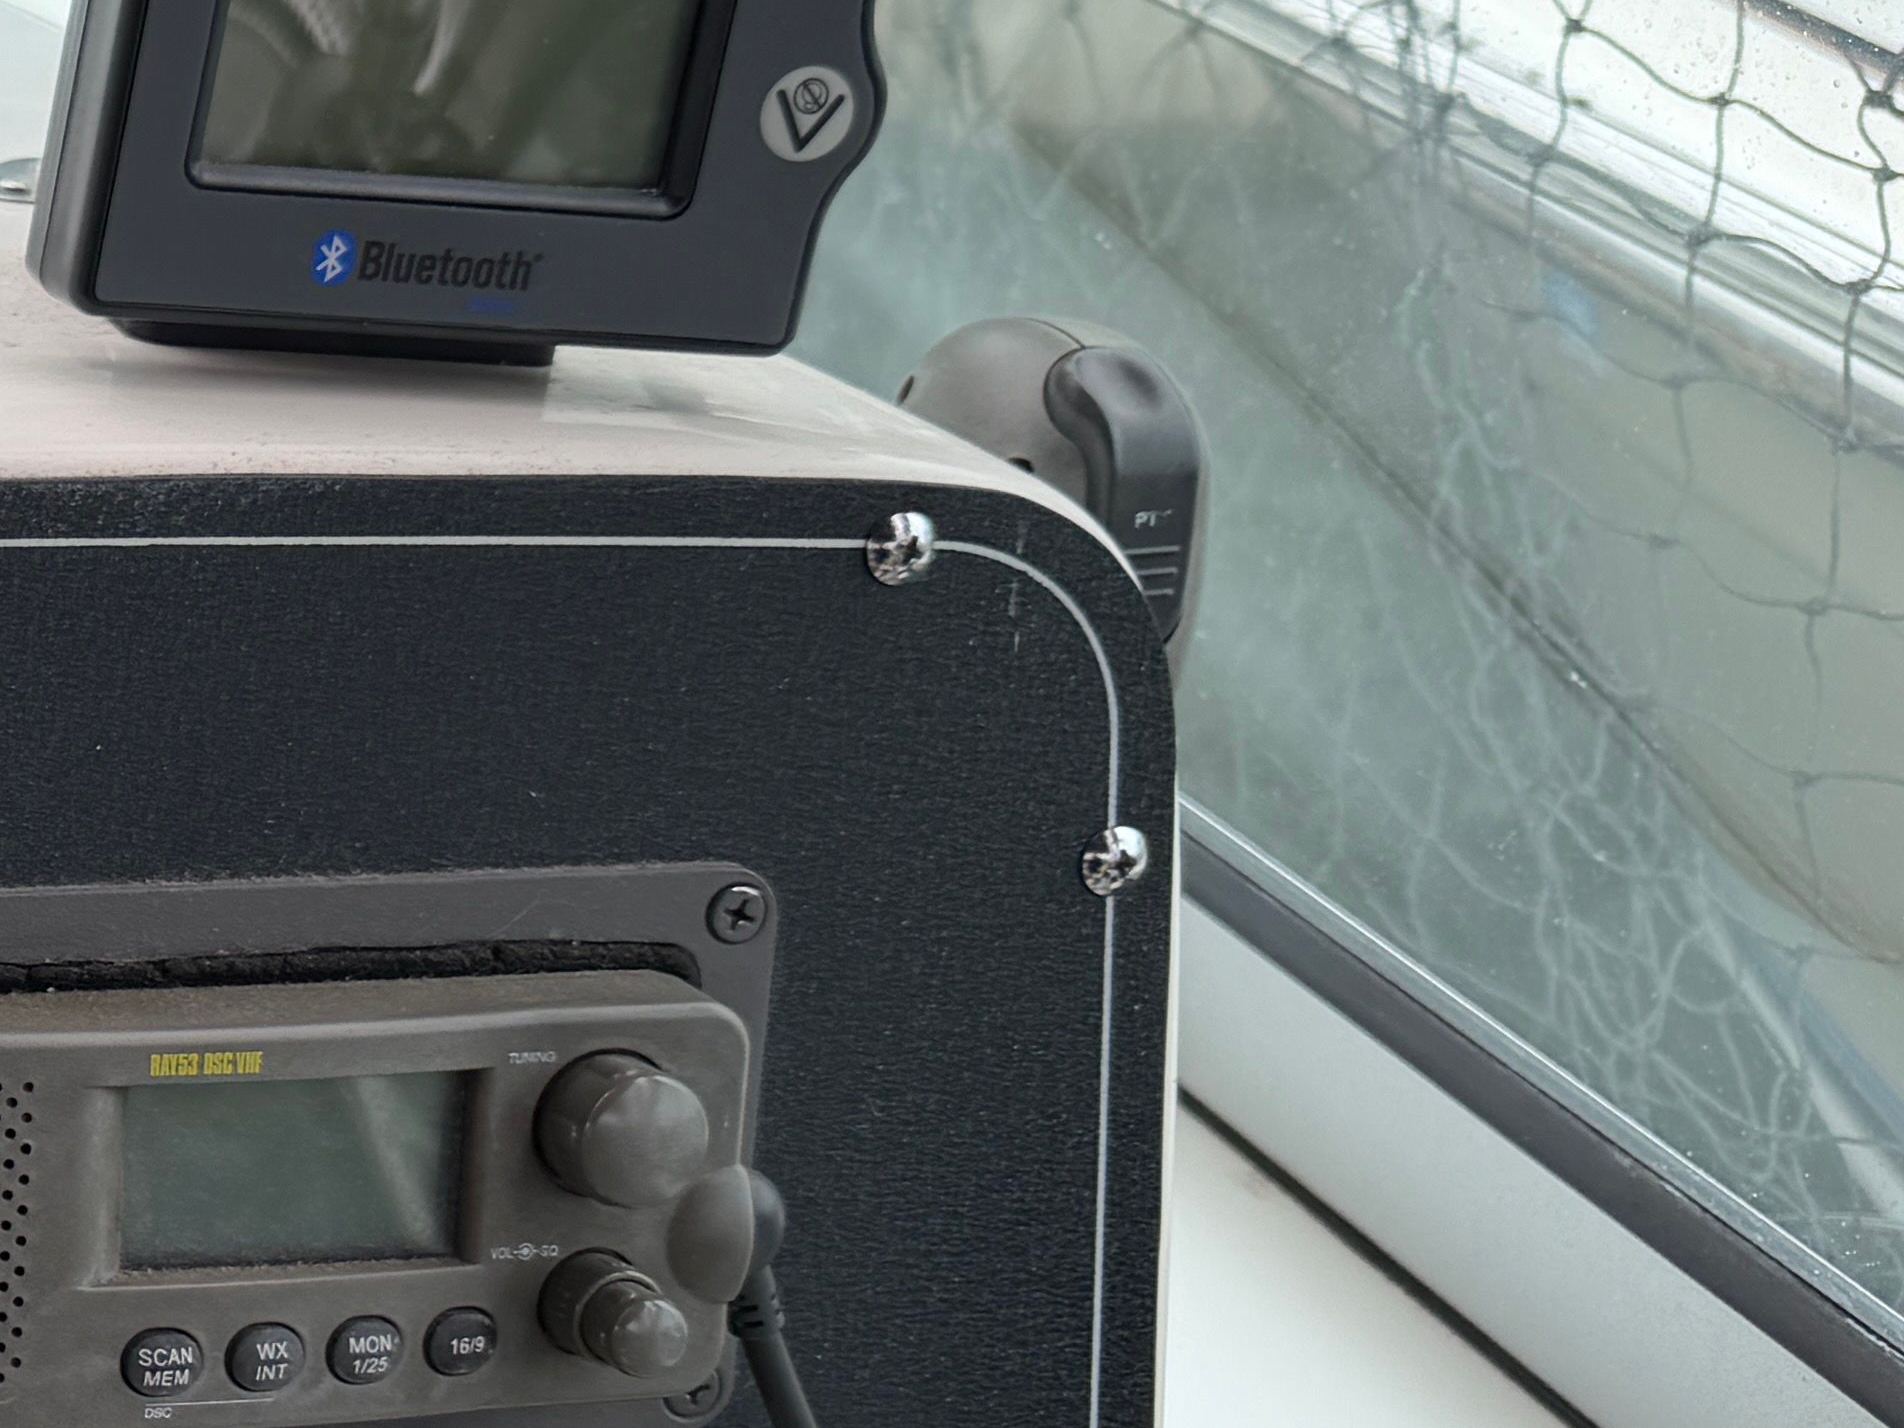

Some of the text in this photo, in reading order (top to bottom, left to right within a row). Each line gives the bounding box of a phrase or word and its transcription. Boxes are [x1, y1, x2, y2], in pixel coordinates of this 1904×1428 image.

[357, 240, 534, 291] Bluetooth
[150, 1051, 264, 1076] RAY53 DSC VHF
[256, 1341, 289, 1361] WX
[348, 1333, 392, 1354] MON
[450, 1335, 486, 1355] 16/9
[137, 1346, 193, 1367] SCAN
[352, 1356, 389, 1374] 1/25
[143, 1369, 190, 1387] MEM
[255, 1363, 289, 1381] INT
[144, 1407, 173, 1419] DSC
